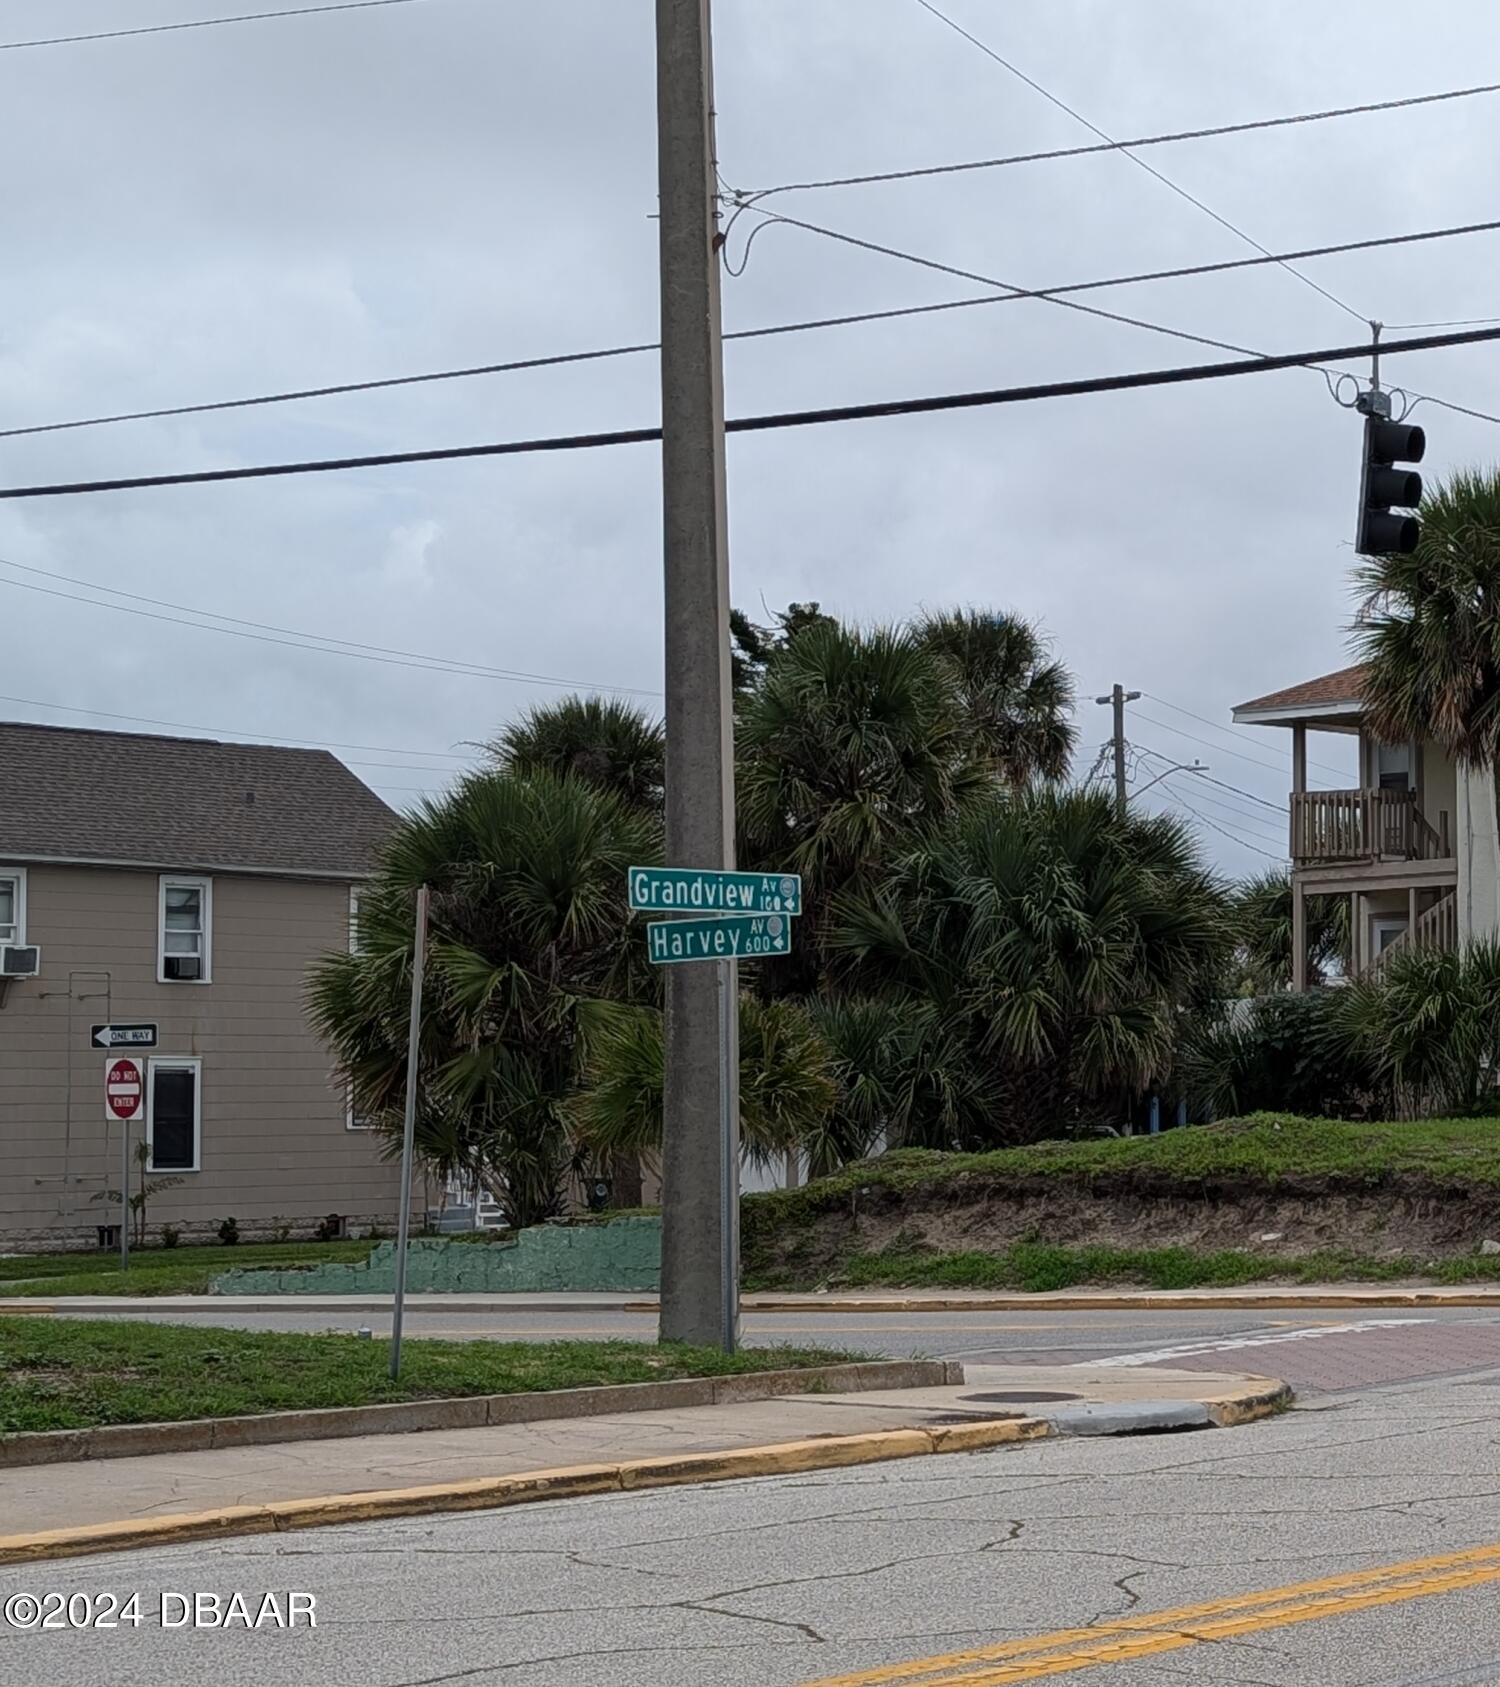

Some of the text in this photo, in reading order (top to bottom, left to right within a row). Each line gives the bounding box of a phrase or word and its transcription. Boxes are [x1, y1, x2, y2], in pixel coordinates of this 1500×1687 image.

[635, 873, 776, 907] Grandview Av
[653, 919, 764, 957] Harvey AV
[746, 936, 770, 952] 600
[111, 1031, 150, 1041] ONE WAY
[111, 1071, 136, 1080] DO NOT
[114, 1097, 134, 1107] ENTER
